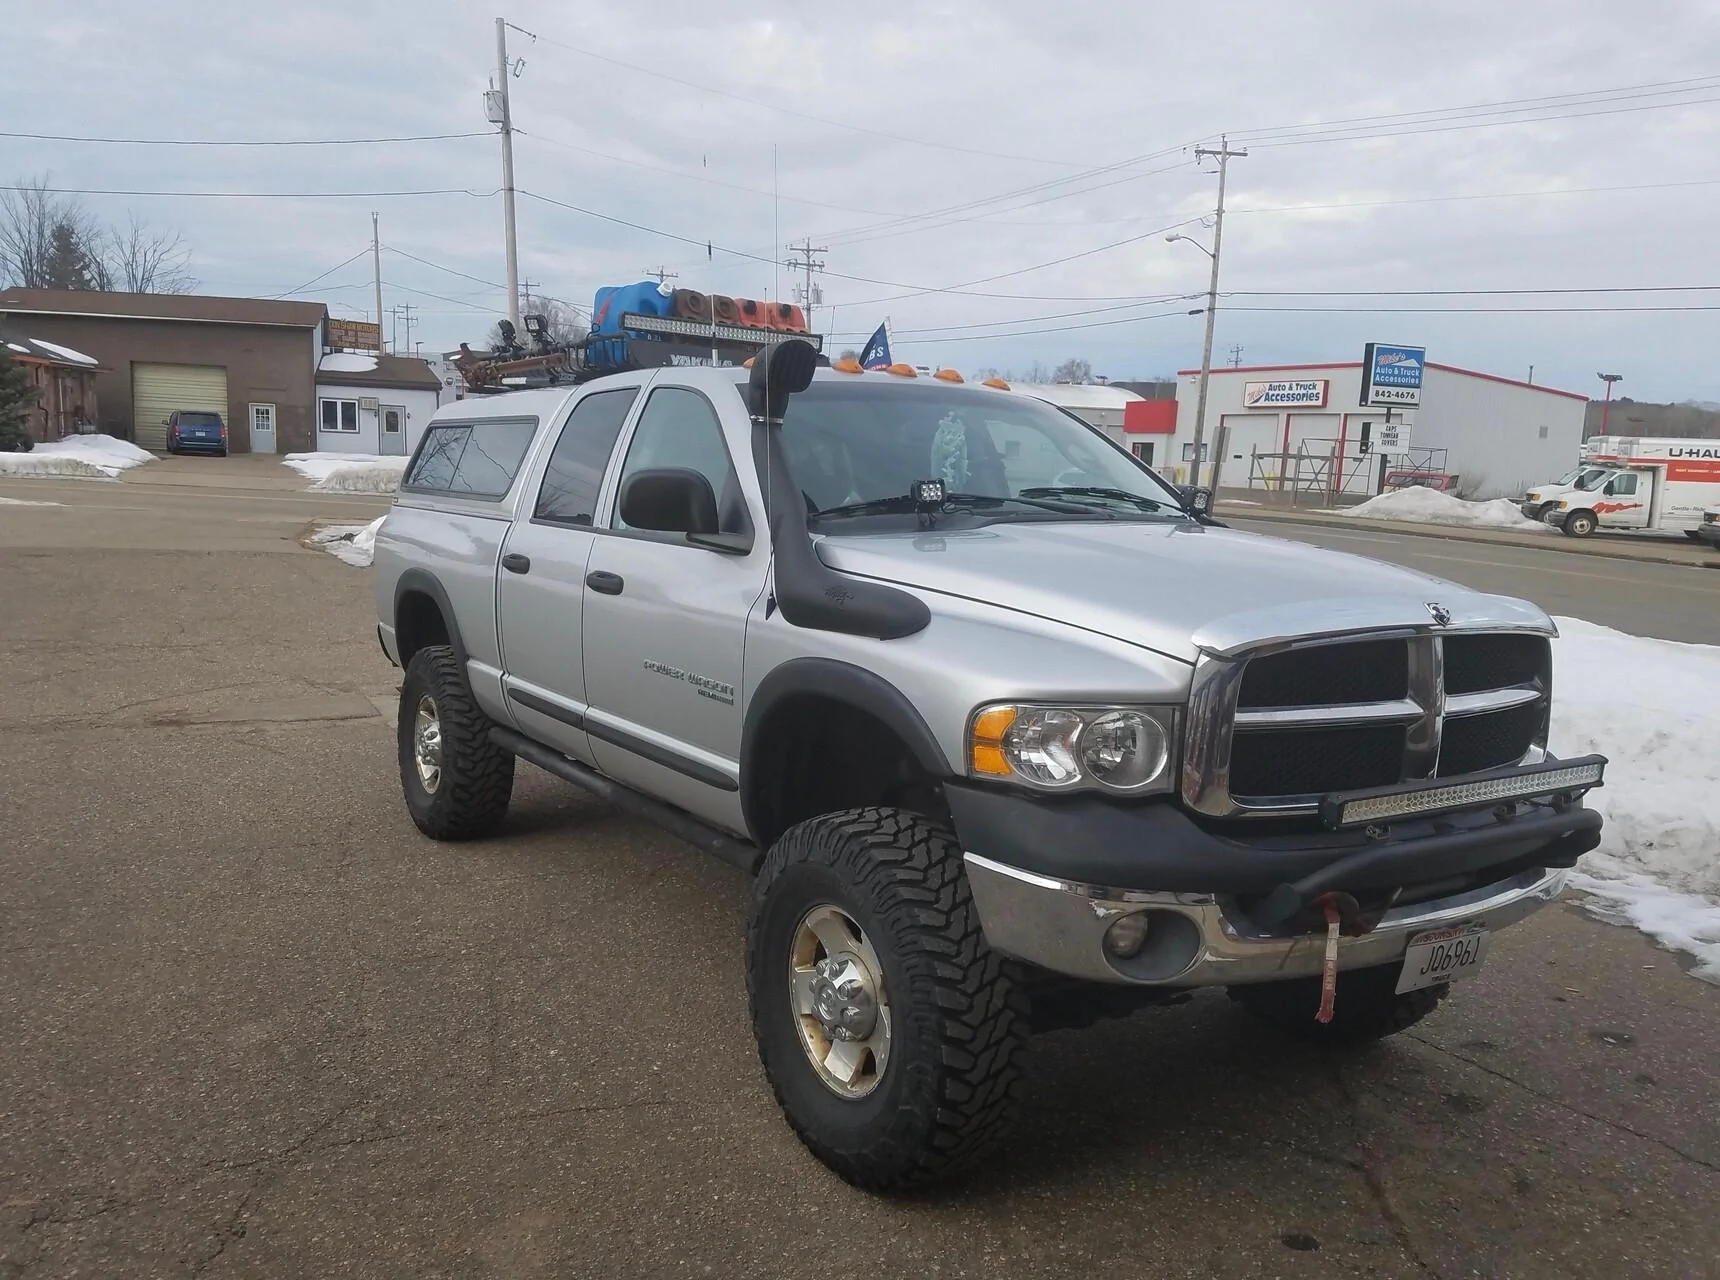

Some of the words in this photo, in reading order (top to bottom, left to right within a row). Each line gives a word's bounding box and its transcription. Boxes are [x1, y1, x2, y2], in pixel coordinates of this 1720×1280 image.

[1376, 366, 1393, 374] Auto
[1400, 368, 1420, 376] Truck
[1375, 374, 1420, 384] Accessories
[1268, 383, 1286, 392] Auto
[1288, 383, 1293, 391] &
[1295, 382, 1317, 391] Truck
[1264, 391, 1320, 402] Accessories
[1374, 390, 1415, 400] 842-4676
[643, 659, 684, 680] POWER
[687, 671, 735, 696] WAGON
